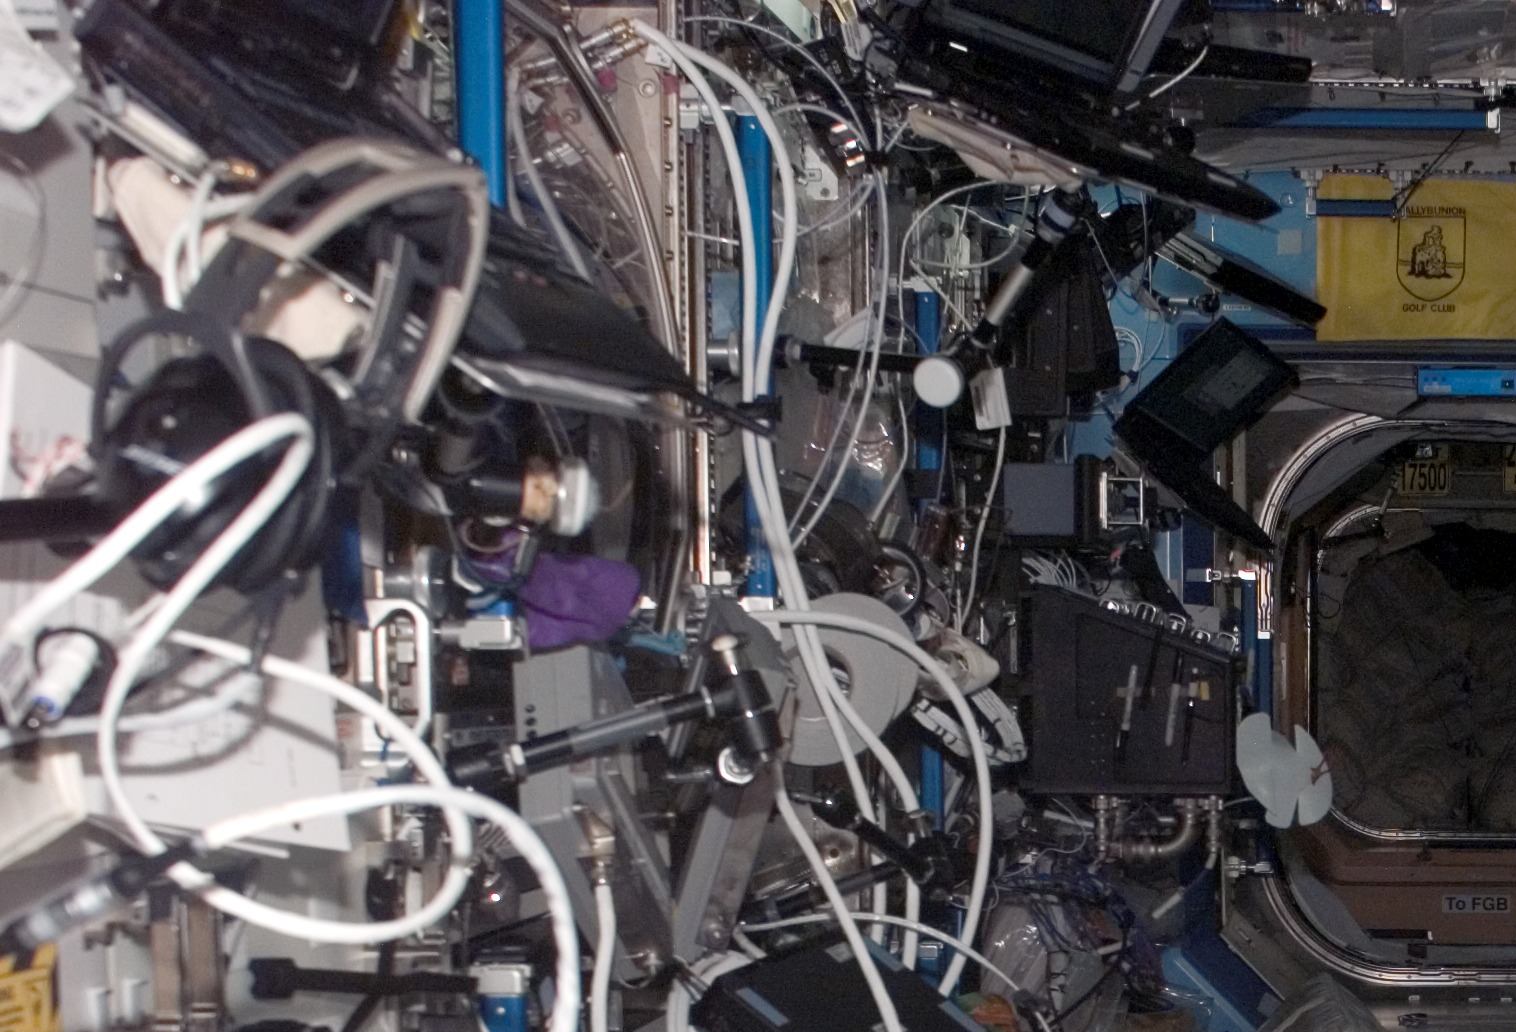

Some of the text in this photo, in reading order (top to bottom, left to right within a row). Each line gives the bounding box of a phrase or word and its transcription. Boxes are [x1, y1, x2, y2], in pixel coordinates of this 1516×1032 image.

[1405, 205, 1466, 216] ALLYBUNION
[1402, 303, 1456, 313] GOLF CLUB
[1402, 463, 1447, 491] 17500
[1445, 896, 1508, 911] To FGB
